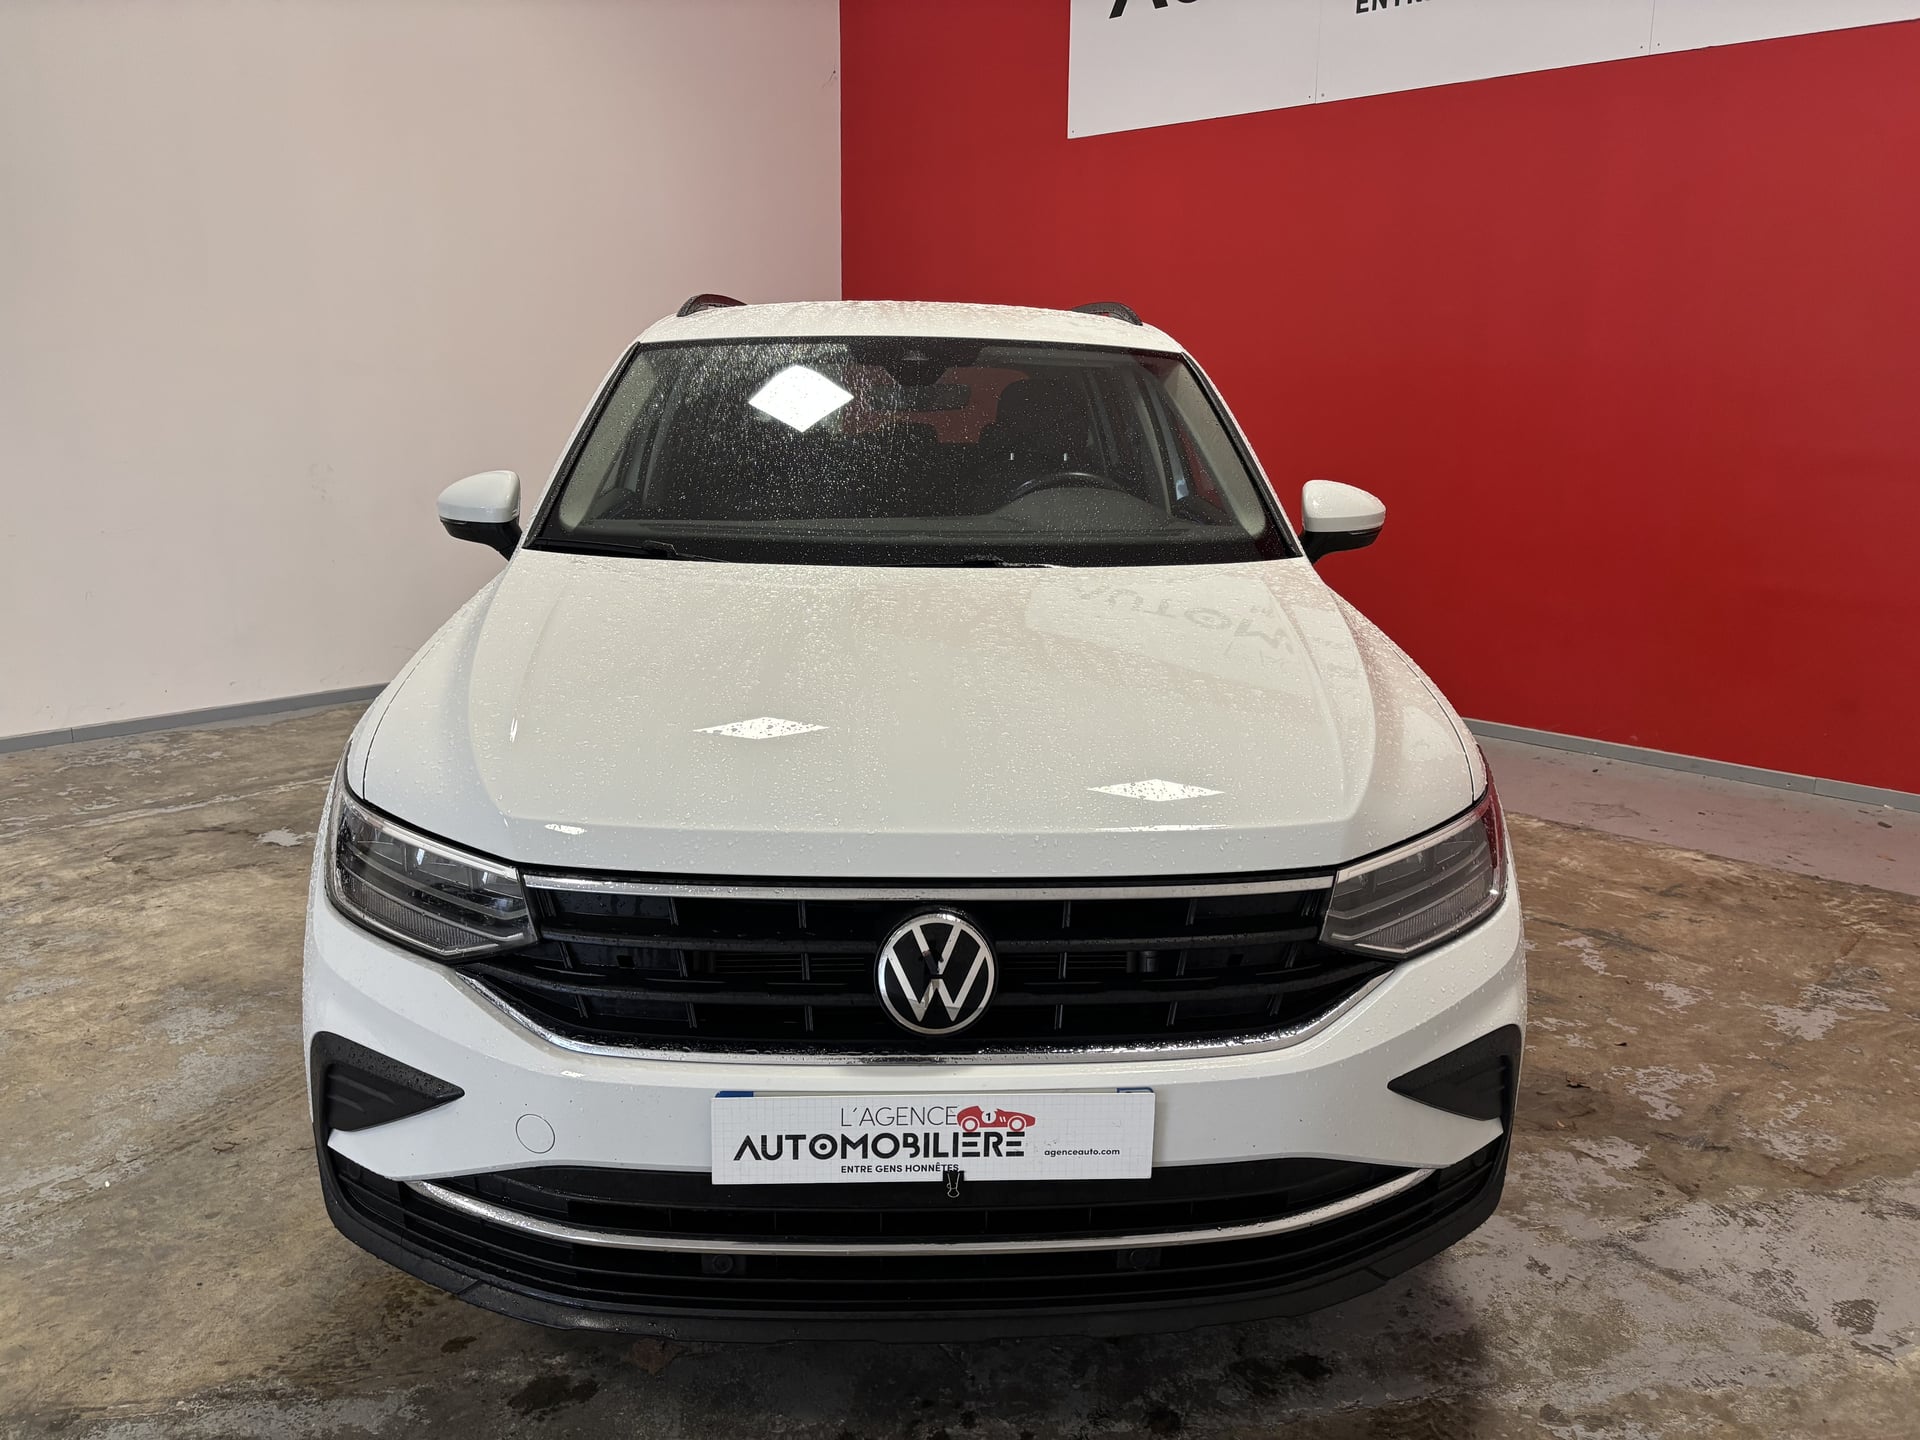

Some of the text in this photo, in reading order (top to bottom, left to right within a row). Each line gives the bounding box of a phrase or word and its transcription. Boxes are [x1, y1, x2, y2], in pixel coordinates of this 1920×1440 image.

[840, 1105, 958, 1127] L'AGENCE
[985, 1112, 992, 1122] 1
[1044, 1148, 1121, 1158] agenceauto.com
[841, 1161, 960, 1173] ENTRE GENS HONNÊTES
